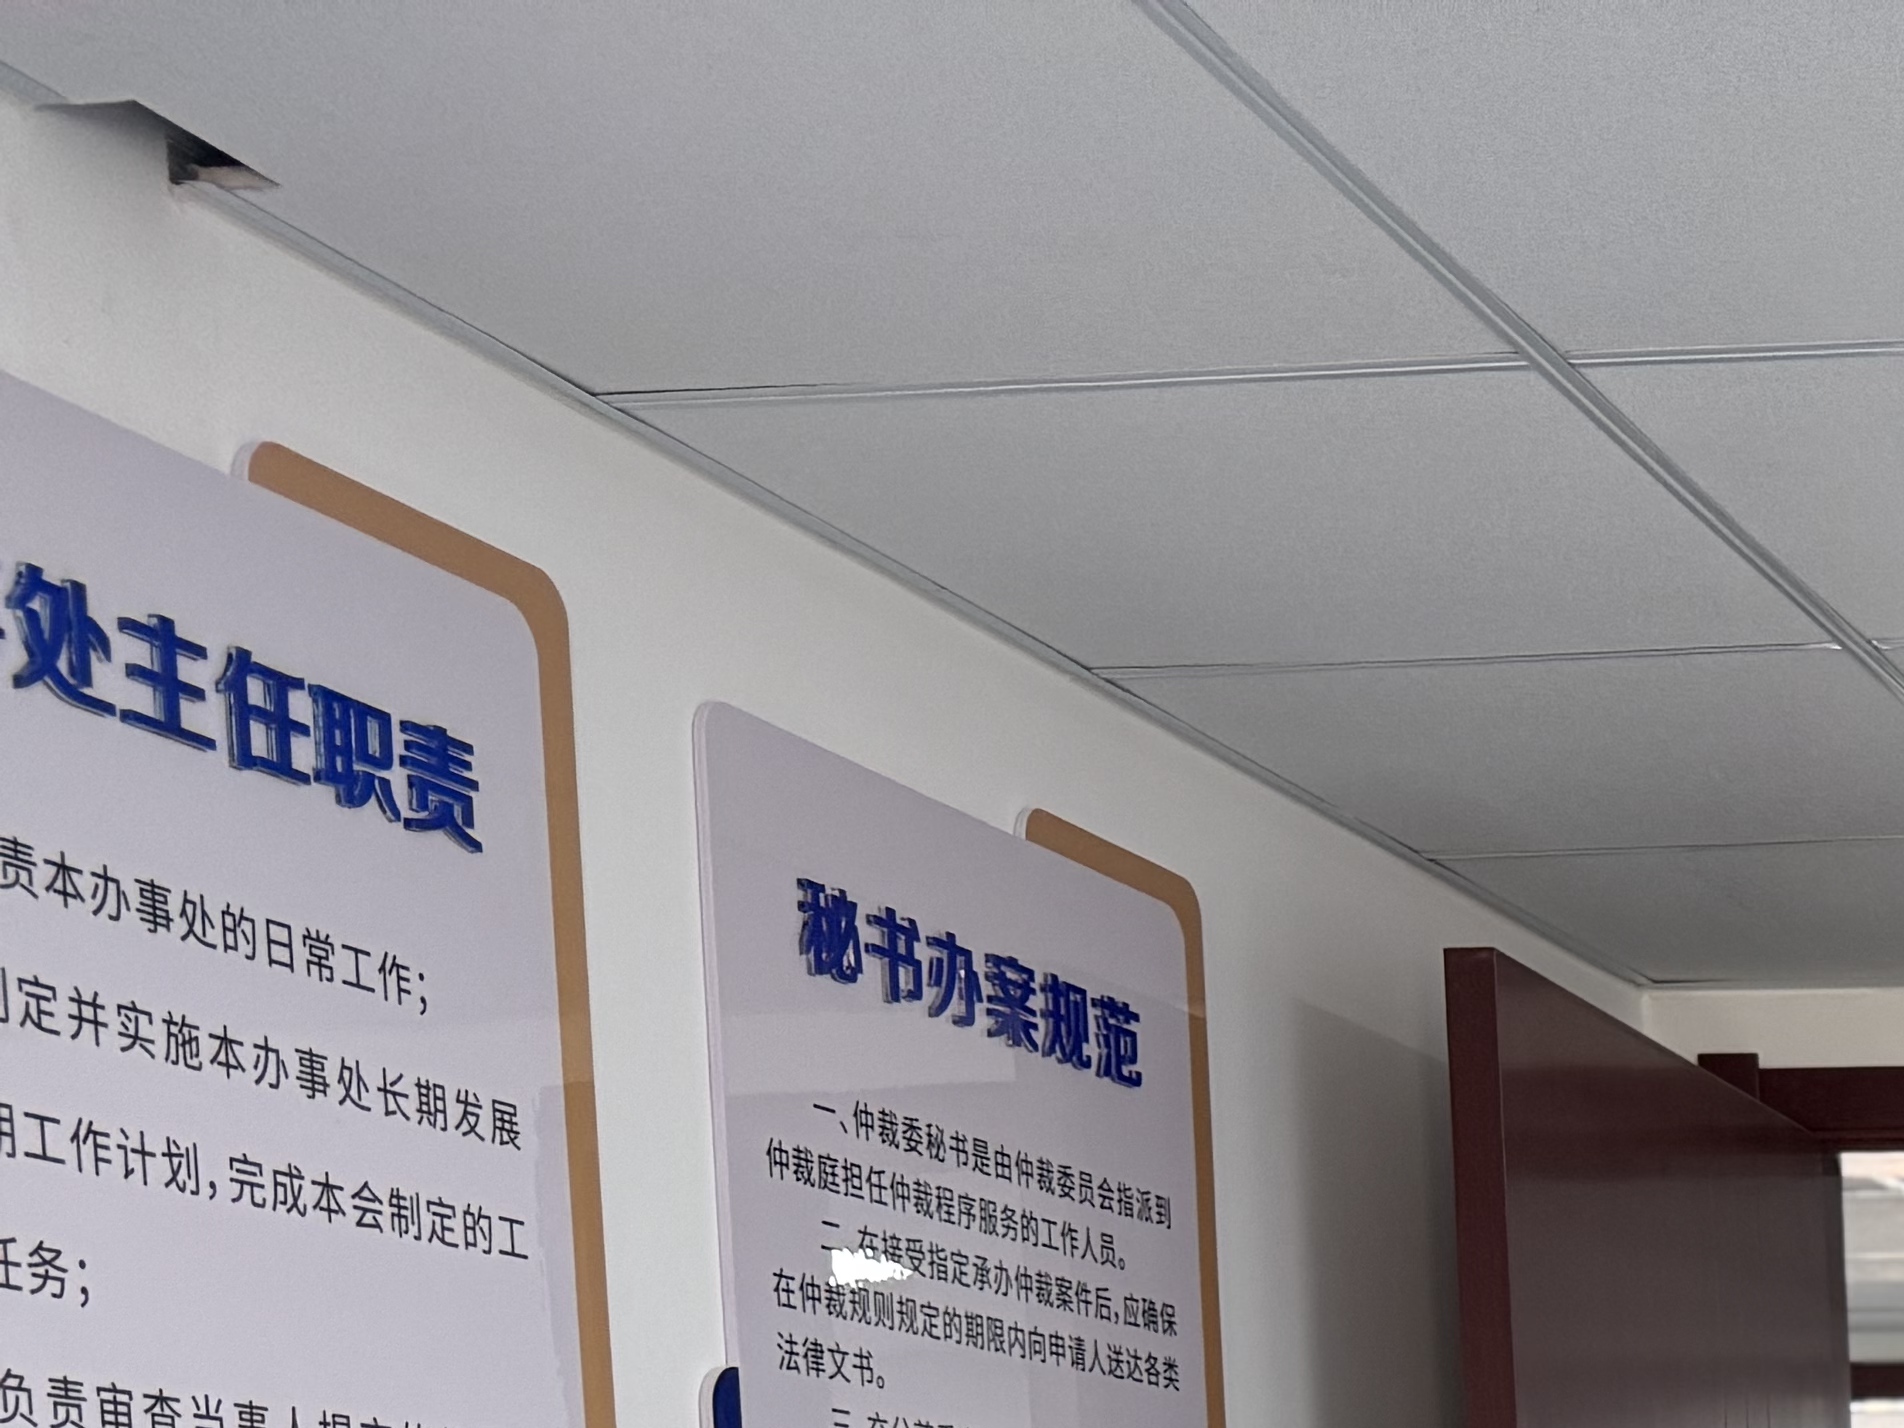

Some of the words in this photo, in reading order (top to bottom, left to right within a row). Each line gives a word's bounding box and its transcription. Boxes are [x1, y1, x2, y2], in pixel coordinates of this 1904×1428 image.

[0, 562, 483, 853] 处主任职责
[796, 877, 1143, 1088] 秘书办案规范
[0, 967, 522, 1151] 定并实施本办事处长期发展
[765, 1137, 1126, 1271] 仲裁庭担任仲裁程序服务的工作人员。
[813, 1100, 1172, 1230] 一、仲裁委秘书是由仲裁委员会指派到
[773, 1268, 1180, 1392] 在仲裁规则规定的期限内向申请人送达各类
[820, 1220, 1178, 1337] 二在接受指定承办仲裁案件后，应确保
[776, 1332, 886, 1391] 法律文书。
